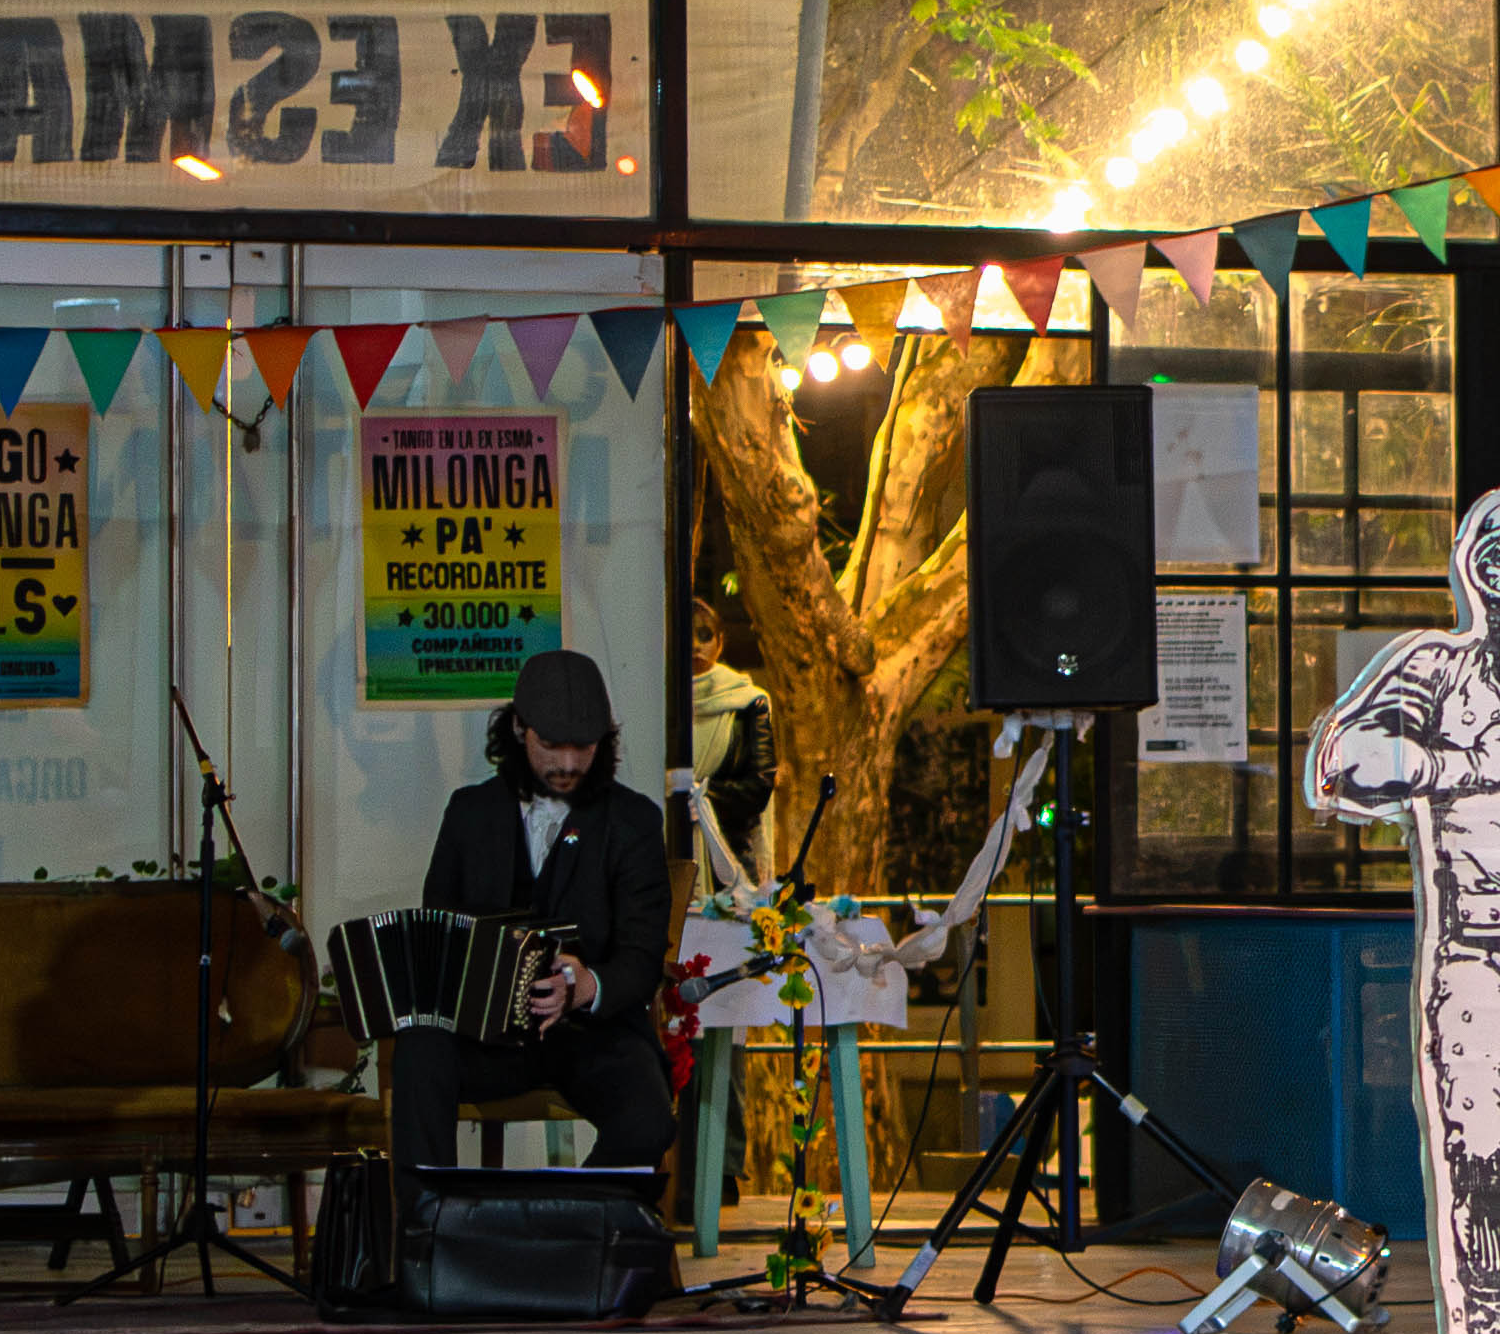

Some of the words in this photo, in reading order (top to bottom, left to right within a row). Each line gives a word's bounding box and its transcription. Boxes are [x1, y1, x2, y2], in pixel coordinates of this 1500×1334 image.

[393, 429, 433, 450] TANGO
[438, 429, 454, 449] EN
[458, 429, 474, 449] LA
[478, 429, 493, 449] EX
[498, 428, 533, 449] ESMA
[372, 453, 553, 511] MILONGA
[436, 516, 492, 555] PA'
[387, 560, 546, 591] RECORDARTE
[423, 601, 510, 630] 30.000
[411, 632, 524, 655] COMPAÑERXS
